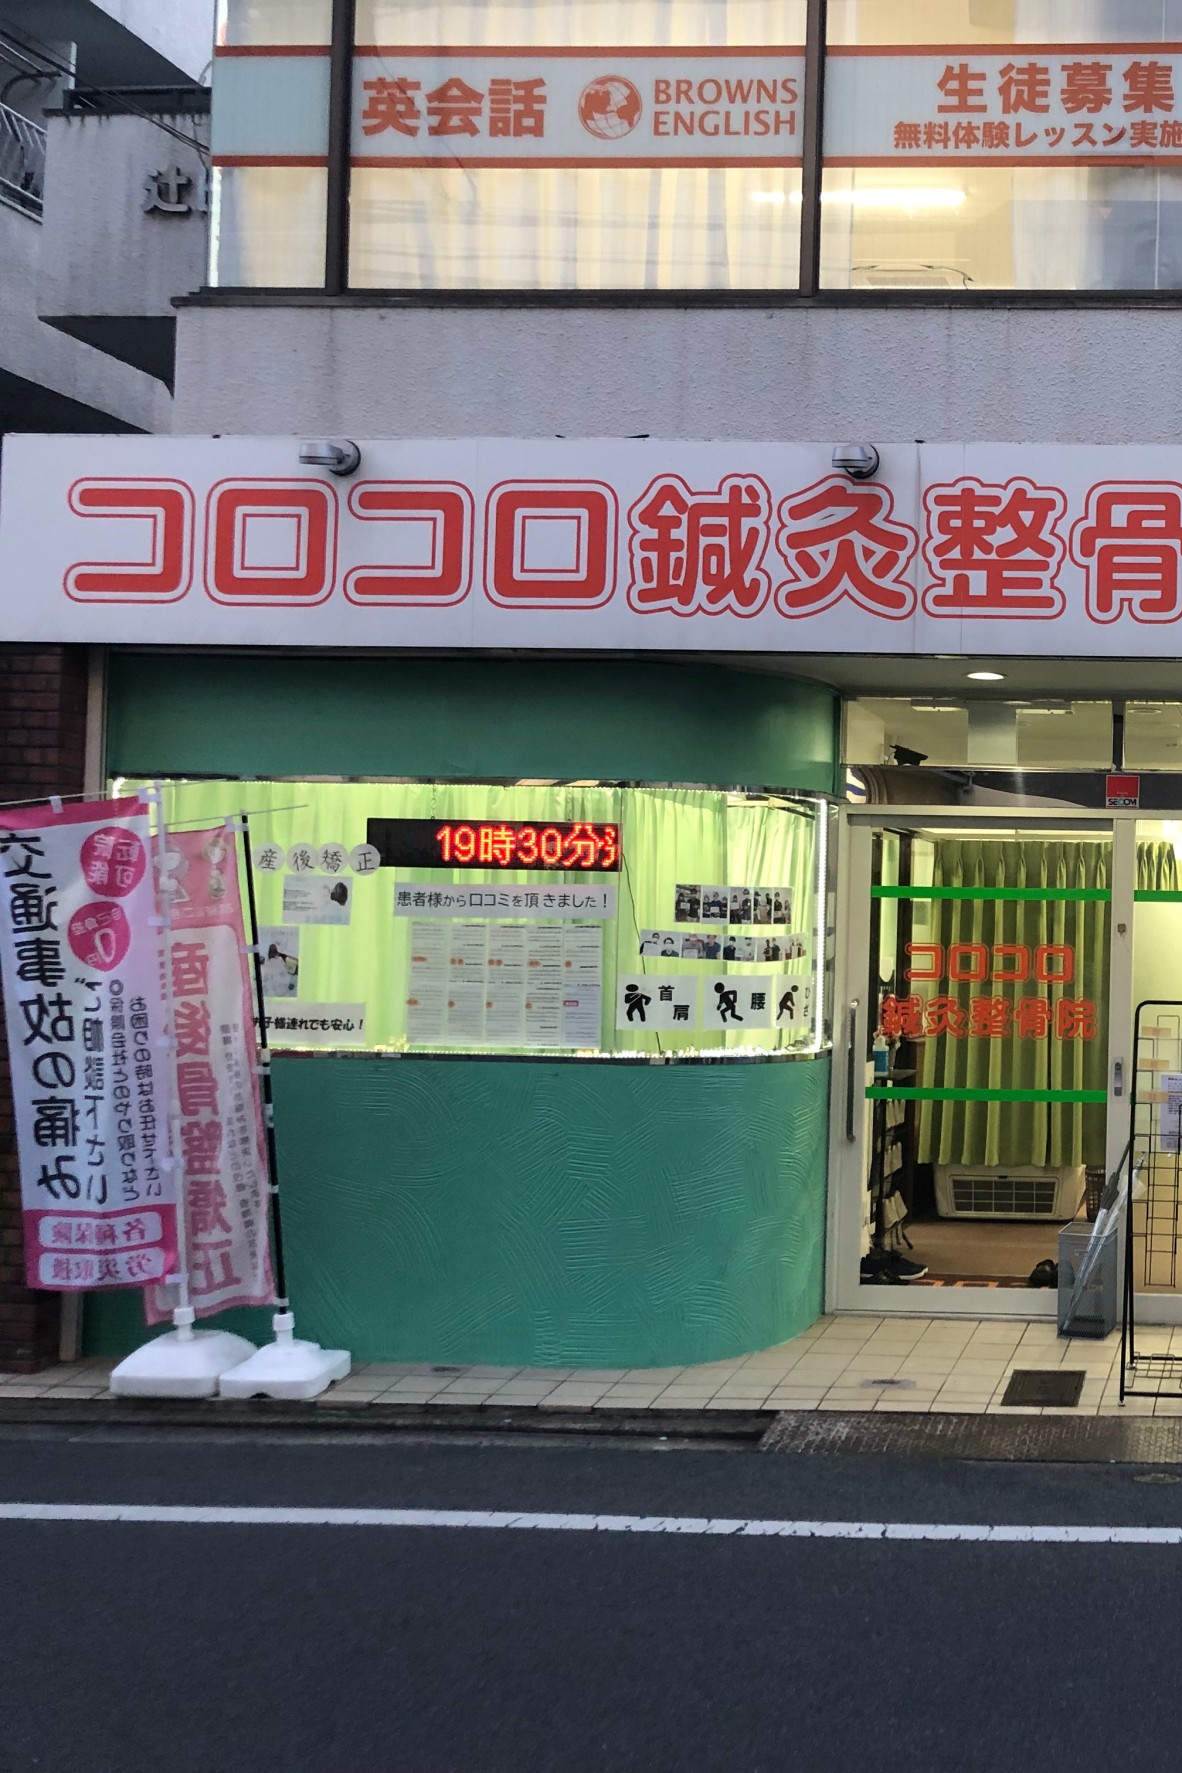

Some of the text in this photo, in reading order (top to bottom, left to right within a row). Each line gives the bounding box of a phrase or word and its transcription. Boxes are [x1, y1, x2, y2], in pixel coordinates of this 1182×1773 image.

[653, 78, 798, 104] BROWNS
[936, 61, 1175, 114] 生徒募集
[361, 77, 547, 137] 英会話
[653, 110, 797, 137] ENGLISH
[143, 164, 208, 214] 辻
[258, 848, 375, 872] 産後矯正
[904, 943, 1075, 983] コロコロ
[658, 985, 675, 1002] 首
[750, 993, 767, 1010] 腰
[673, 1005, 690, 1021] 肩
[880, 993, 1098, 1041] 鍼灸整骨院
